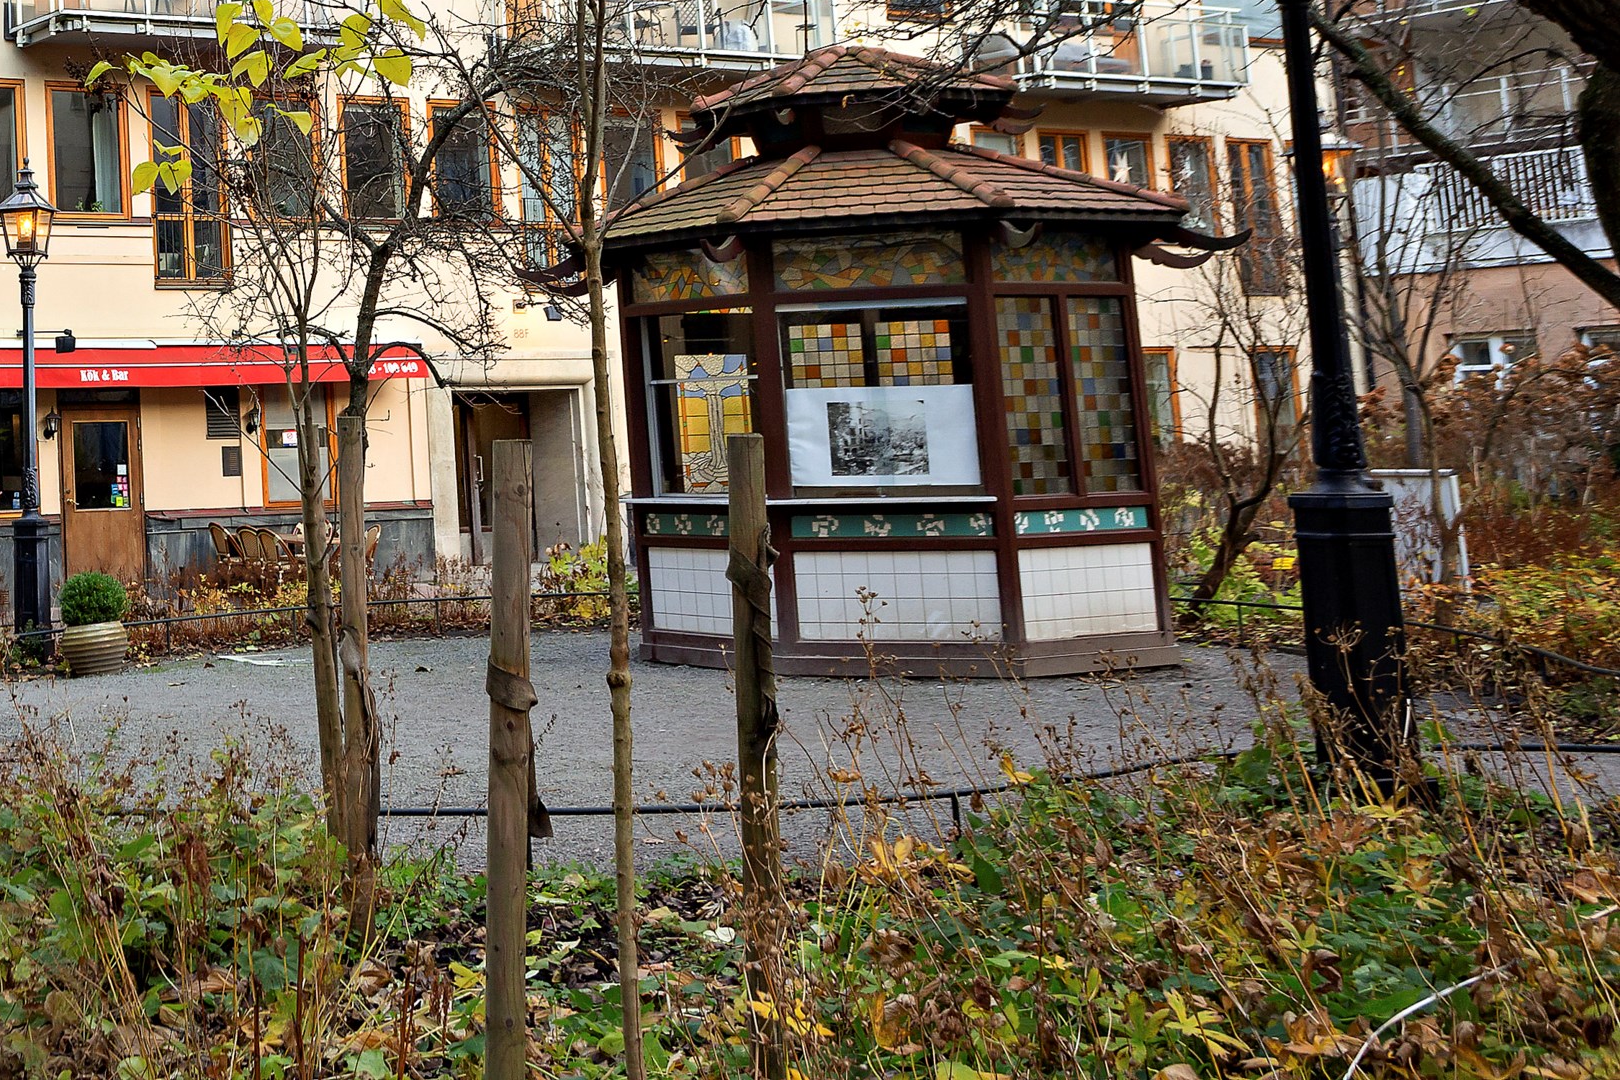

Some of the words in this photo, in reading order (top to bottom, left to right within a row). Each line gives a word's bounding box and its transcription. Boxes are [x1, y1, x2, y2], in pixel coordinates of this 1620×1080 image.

[80, 369, 100, 381] Kök
[101, 369, 110, 381] &
[111, 368, 128, 381] Bar
